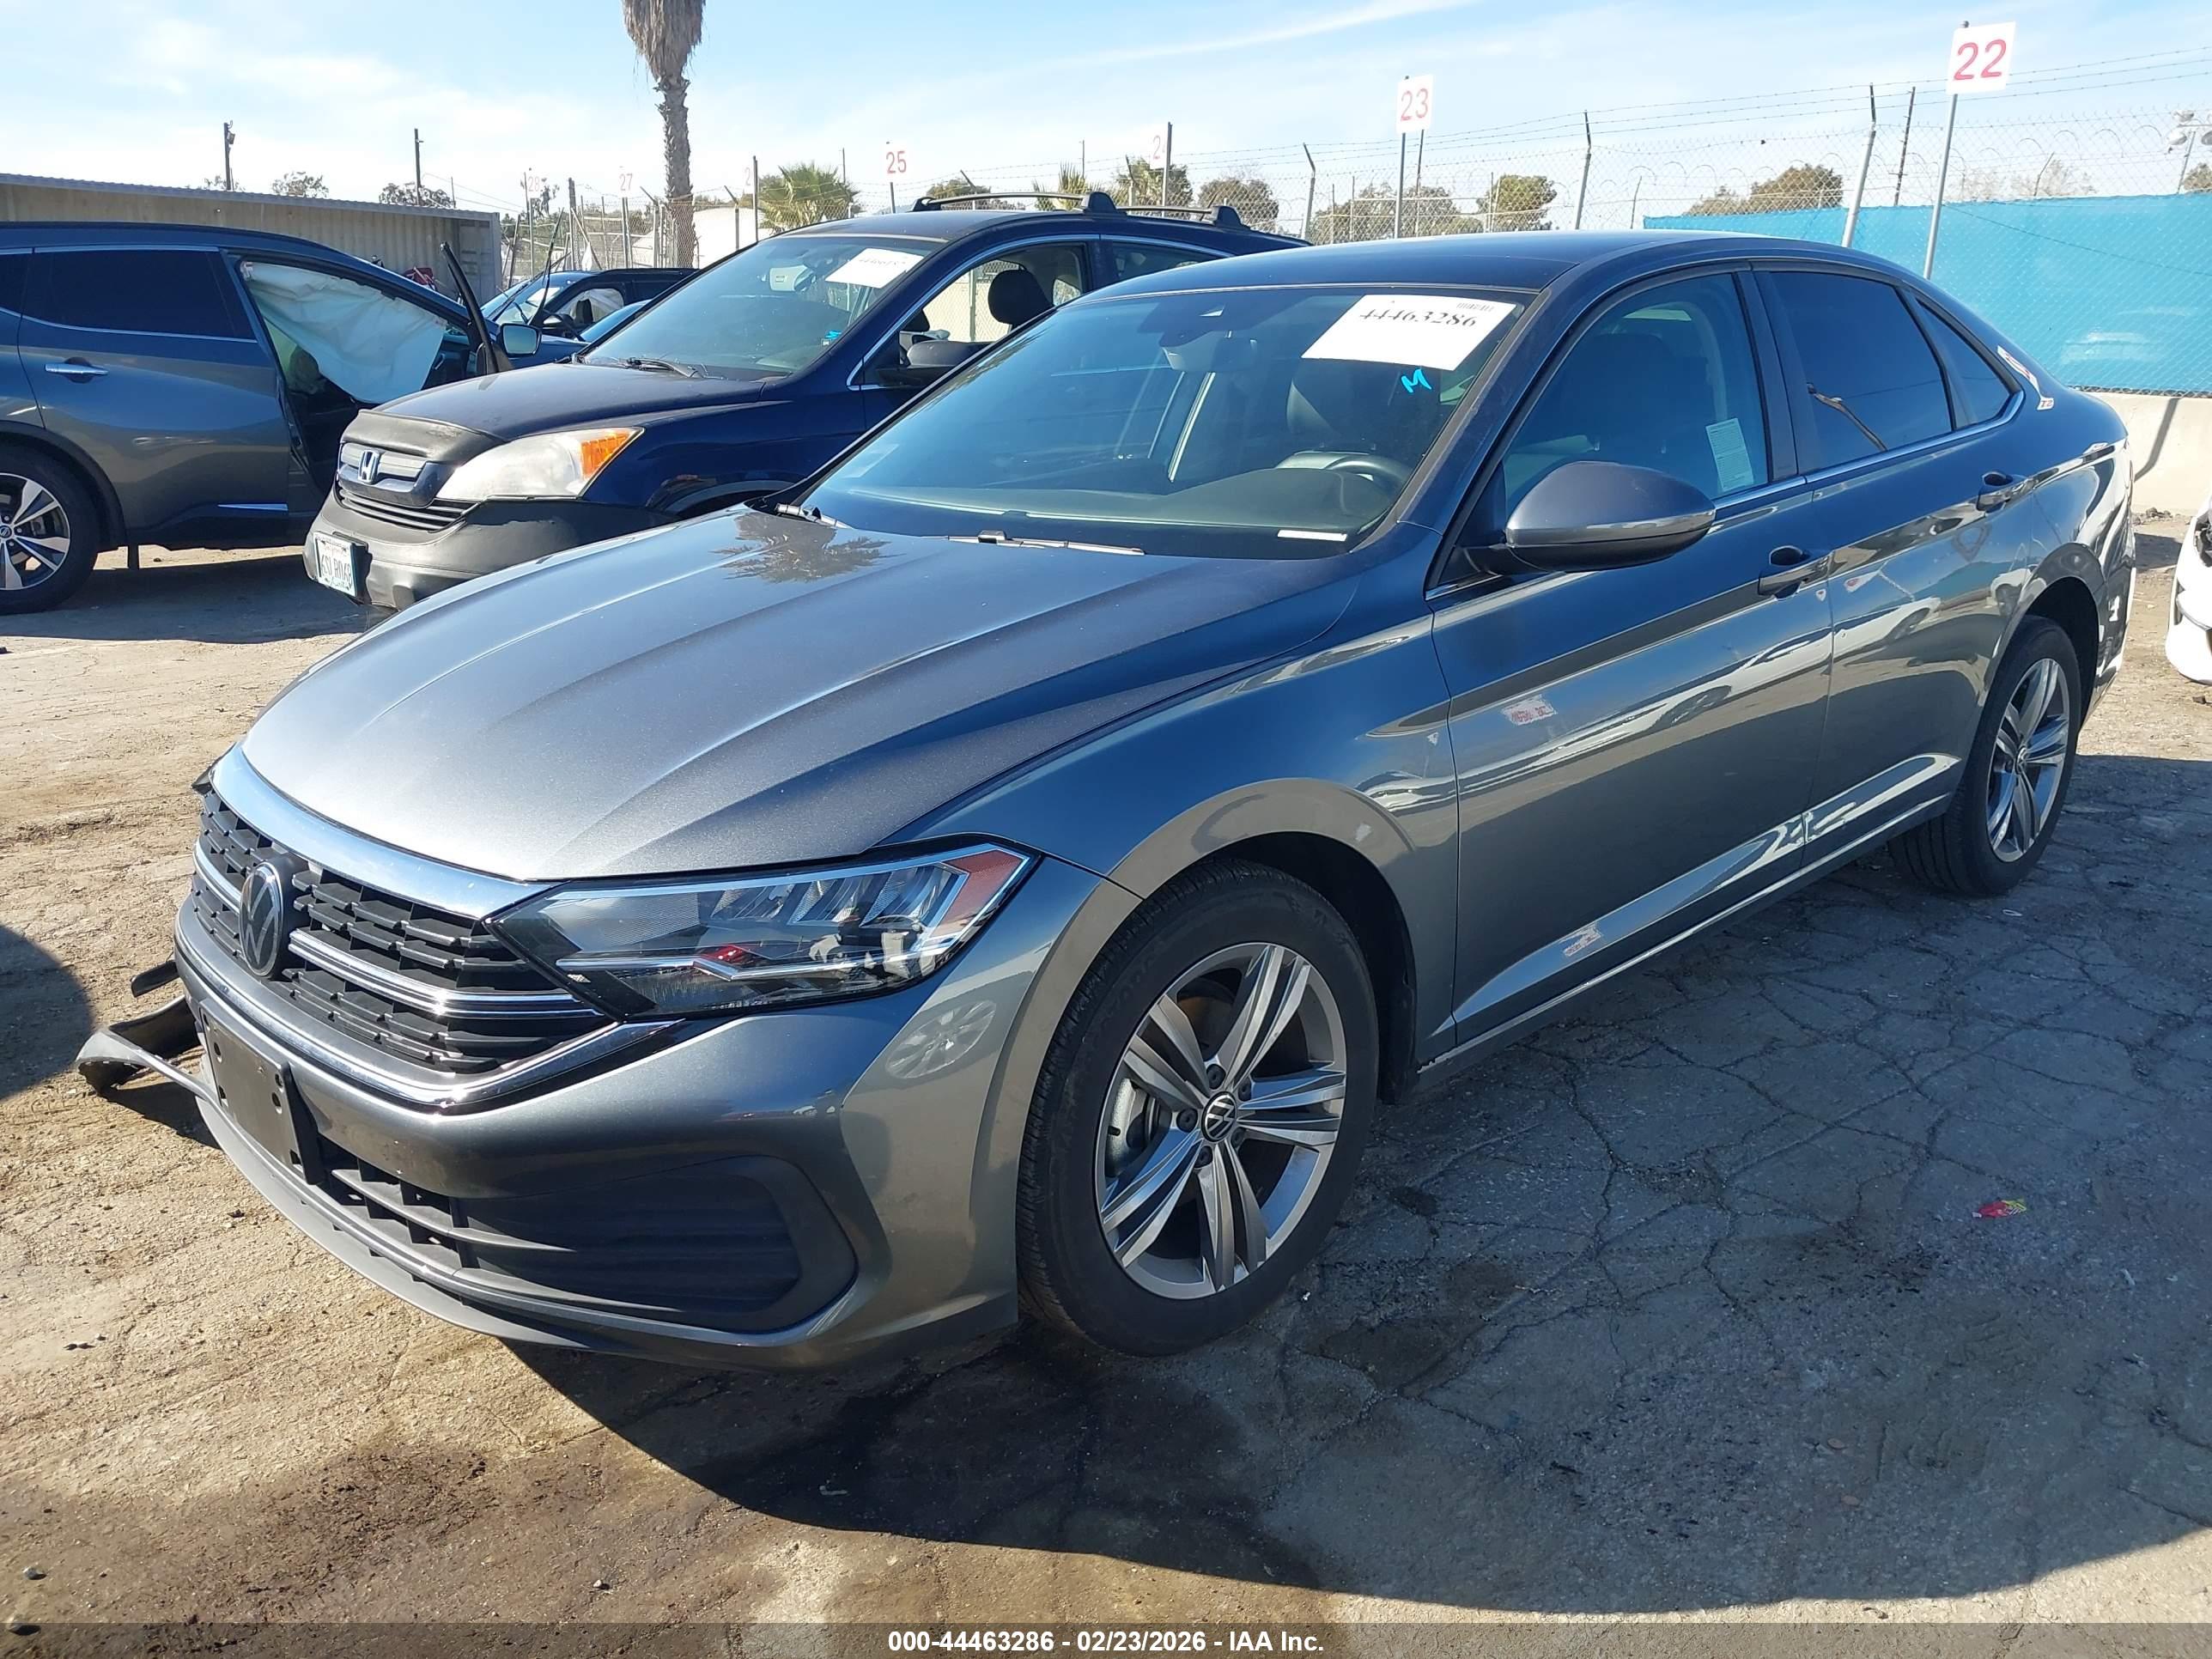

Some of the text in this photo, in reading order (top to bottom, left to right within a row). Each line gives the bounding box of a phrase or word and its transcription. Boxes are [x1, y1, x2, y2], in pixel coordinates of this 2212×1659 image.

[1954, 39, 2007, 81] 22
[1400, 88, 1429, 121] 23
[885, 150, 908, 174] 25
[527, 175, 541, 192] 28
[618, 173, 634, 191] 27
[1359, 307, 1477, 328] 44463286
